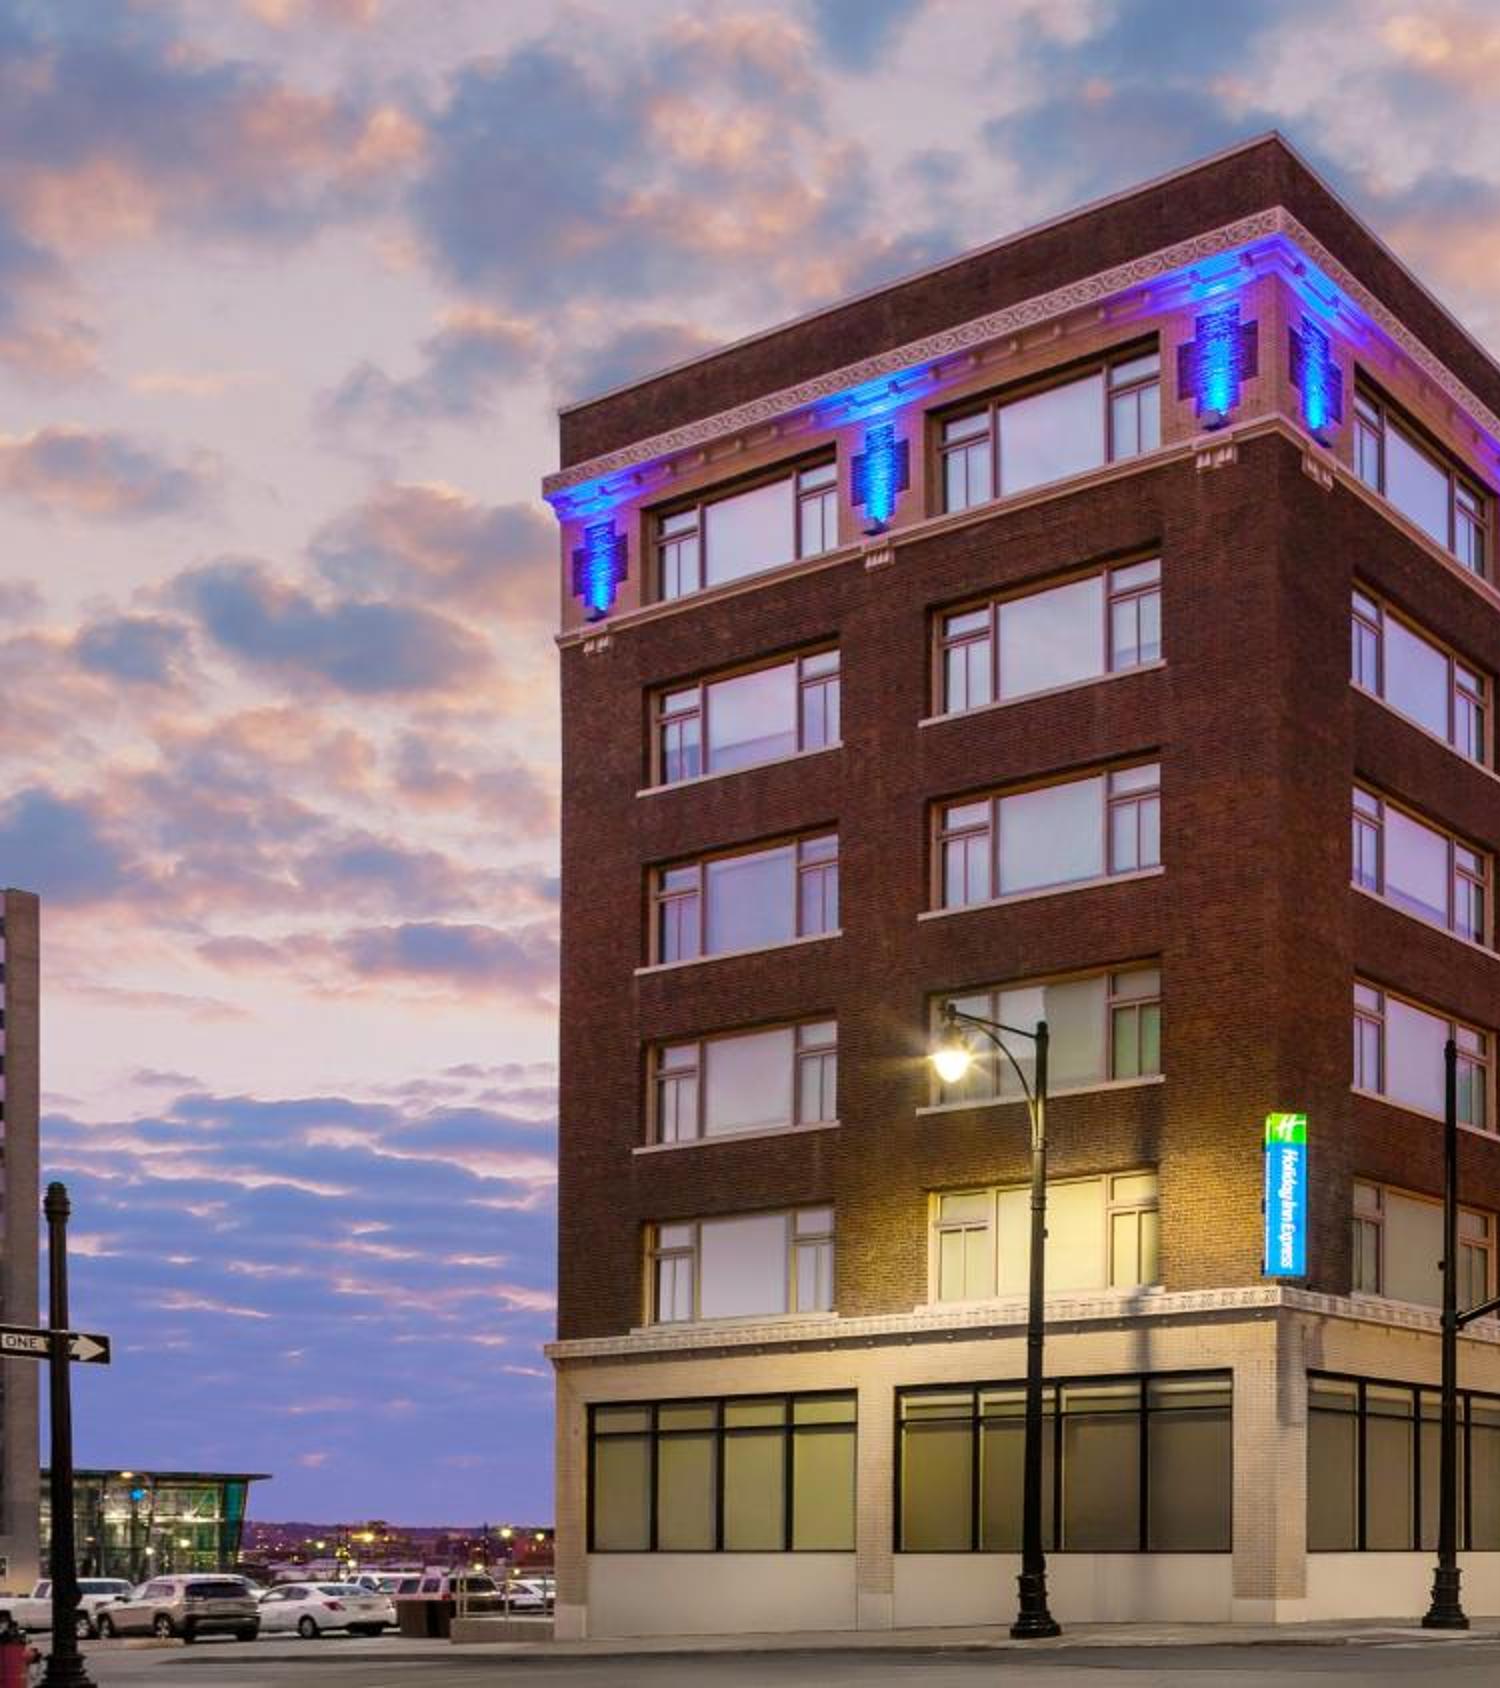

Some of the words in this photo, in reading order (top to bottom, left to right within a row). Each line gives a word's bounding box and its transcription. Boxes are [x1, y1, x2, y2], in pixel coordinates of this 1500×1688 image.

[1278, 1149, 1299, 1199] Holiday
[1280, 1200, 1298, 1221] Inn
[1278, 1222, 1297, 1269] Express
[6, 1335, 38, 1348] ONE
